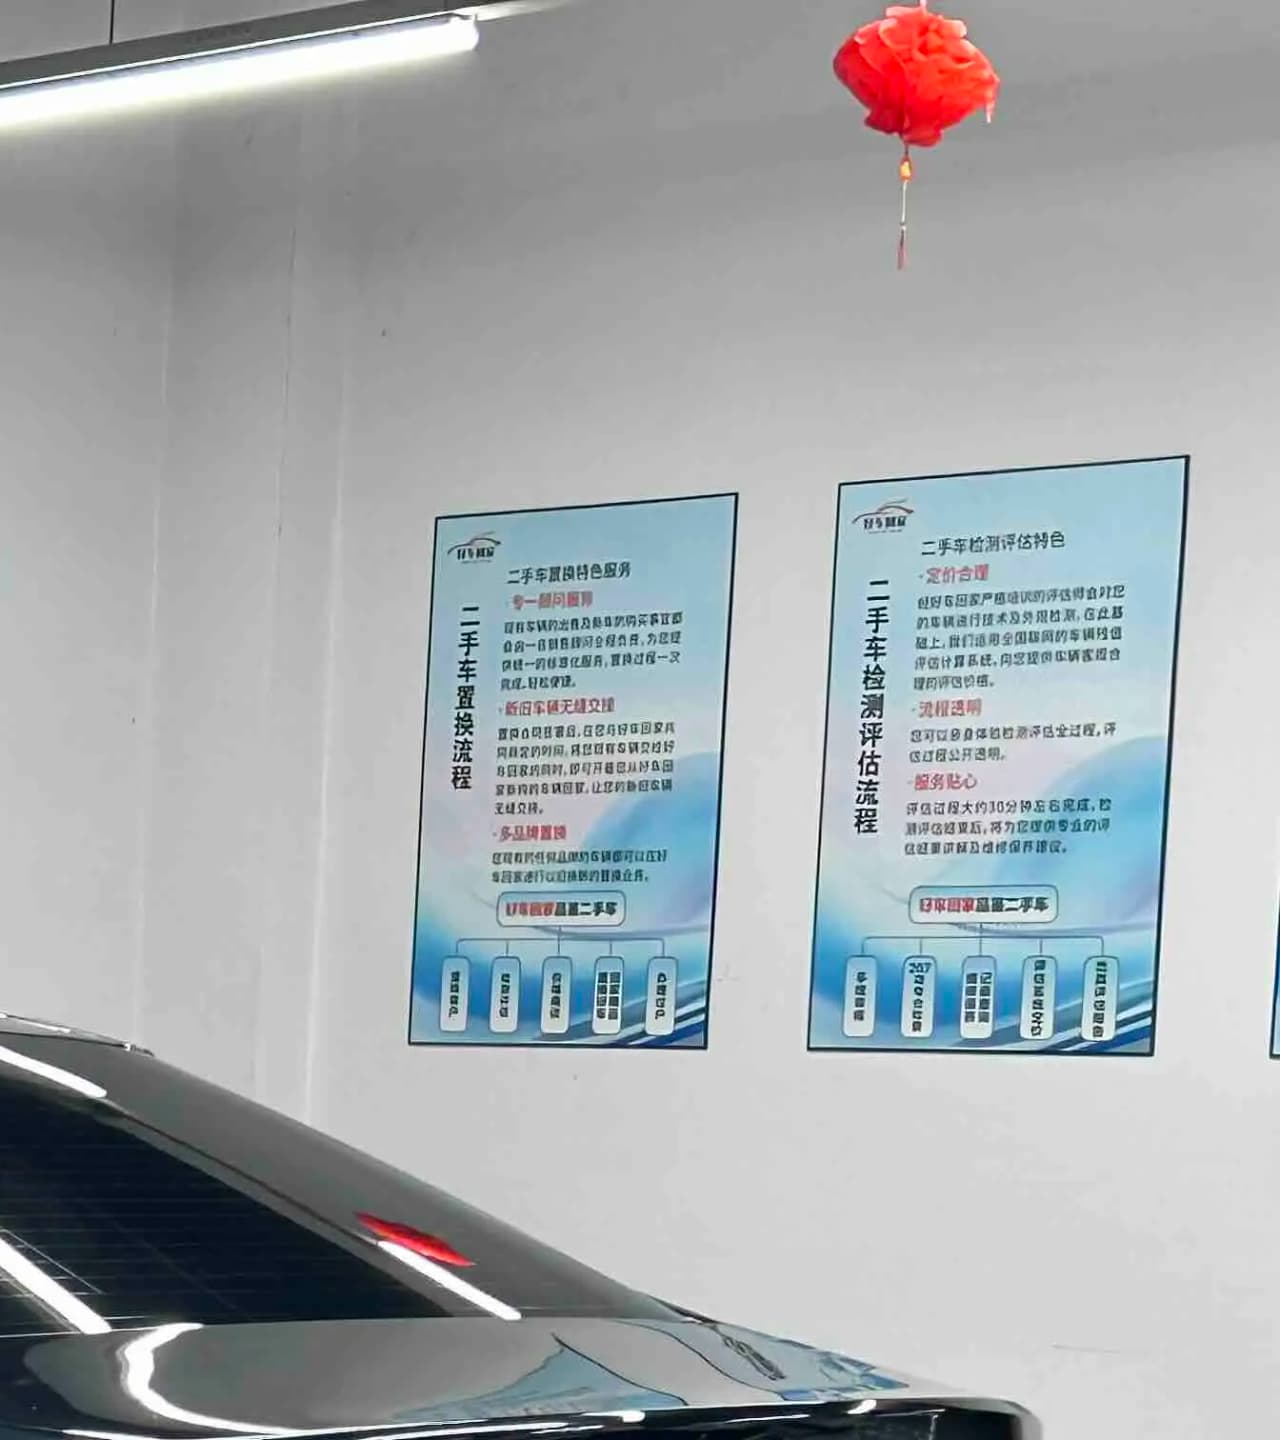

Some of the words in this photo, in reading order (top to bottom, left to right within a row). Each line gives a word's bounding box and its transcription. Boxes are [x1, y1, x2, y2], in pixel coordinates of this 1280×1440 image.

[451, 606, 481, 790] 二手车置换流程
[854, 579, 890, 834] 二手车检测评估流程
